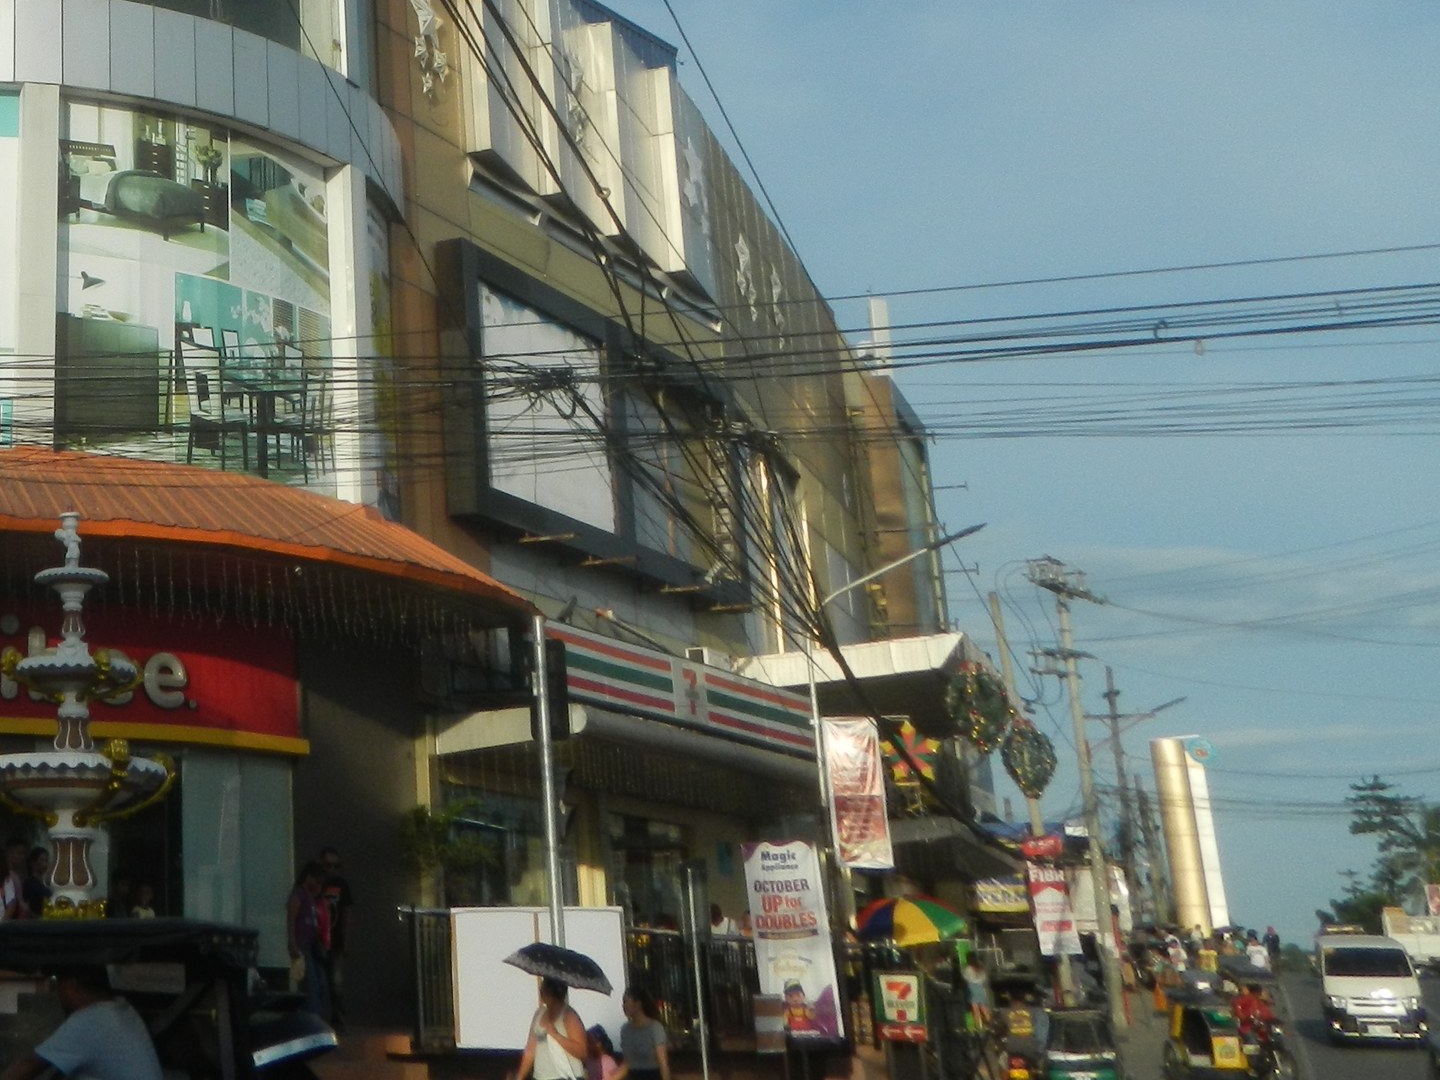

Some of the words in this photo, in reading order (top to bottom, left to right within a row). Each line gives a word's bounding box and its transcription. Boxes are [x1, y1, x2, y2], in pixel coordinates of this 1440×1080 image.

[760, 849, 797, 865] Magic
[753, 879, 811, 893] OCTOBER
[761, 894, 782, 914] UP
[755, 910, 817, 929] DOUBLES
